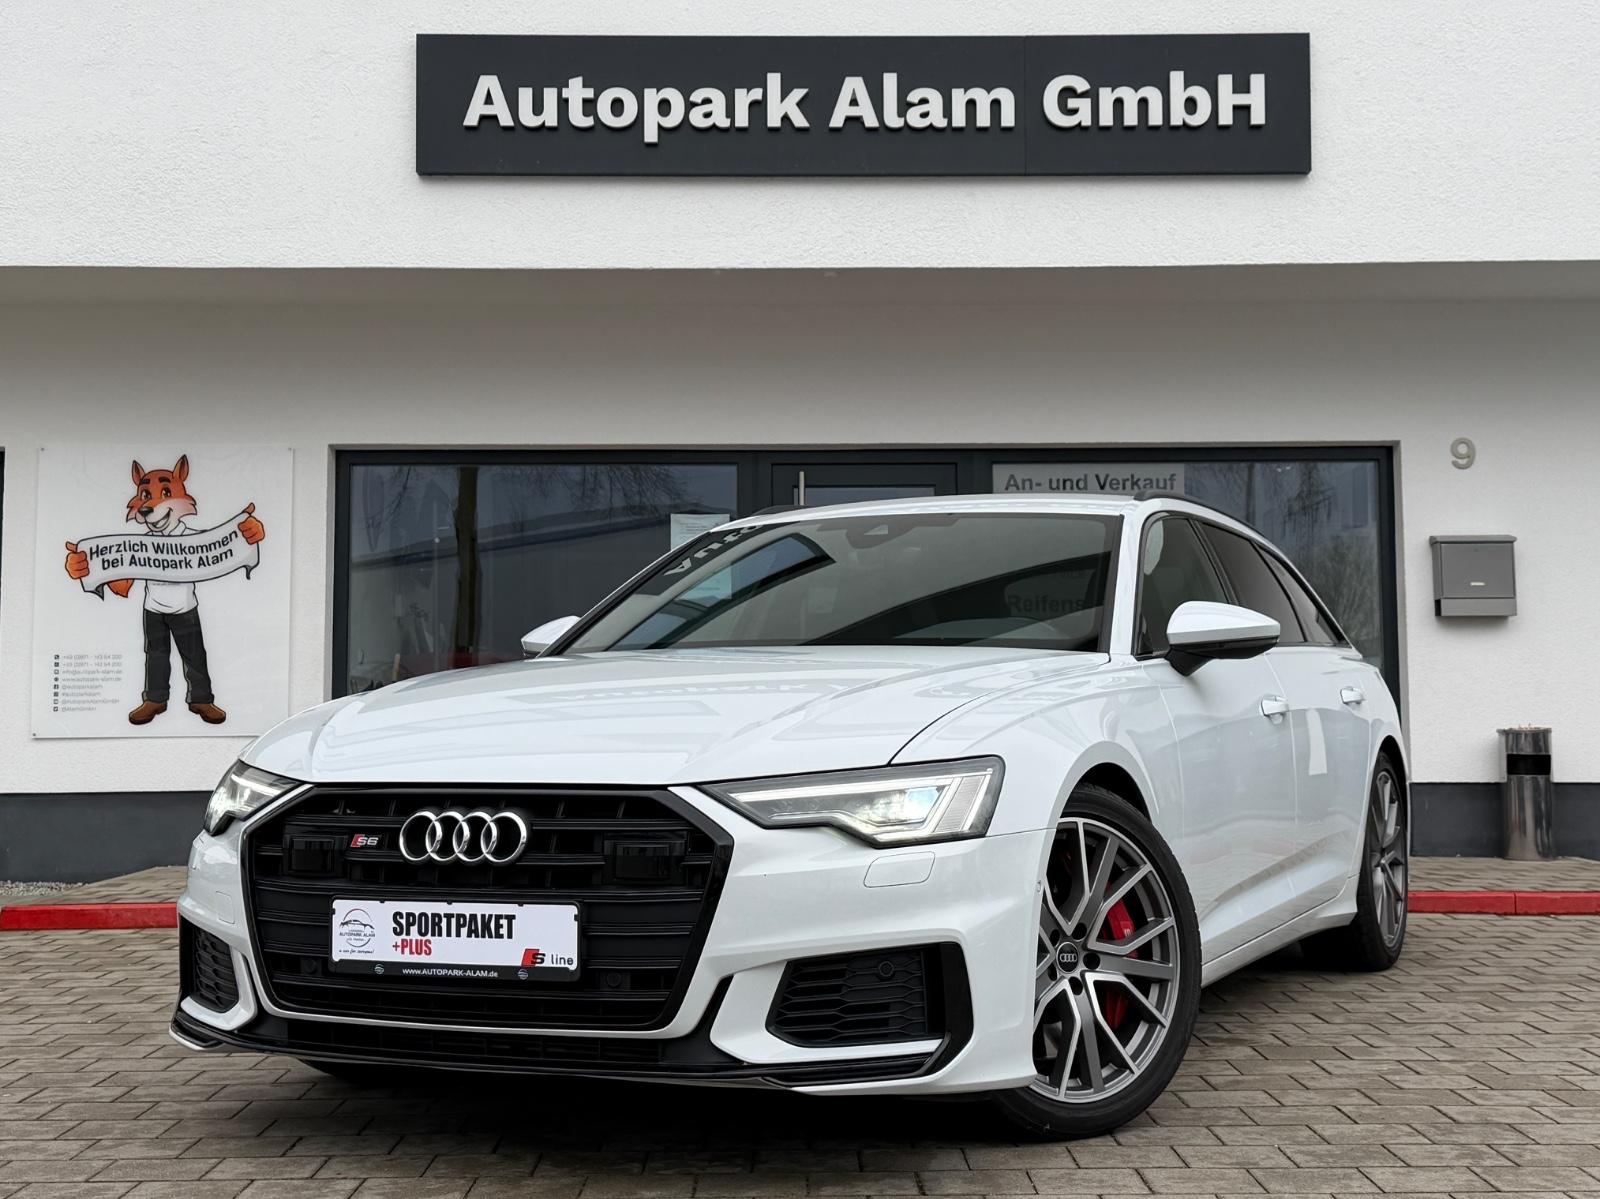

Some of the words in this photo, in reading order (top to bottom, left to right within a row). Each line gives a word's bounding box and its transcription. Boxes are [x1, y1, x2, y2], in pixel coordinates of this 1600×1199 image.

[462, 72, 811, 145] Autopark
[828, 72, 1017, 131] Alam
[1042, 71, 1268, 130] GmbH
[1450, 437, 1476, 470] 9
[1004, 474, 1042, 491] An-
[1048, 474, 1088, 491] und
[1095, 473, 1177, 491] Verkauf
[89, 540, 148, 561] Herzlich
[151, 530, 239, 556] Willkommen
[101, 554, 124, 571] bei
[129, 554, 193, 571] Autopark
[197, 548, 234, 569] Alam
[355, 836, 379, 846] S6
[392, 911, 516, 939] SPORTPAKET
[392, 938, 433, 956] +PLUS
[551, 954, 574, 966] line
[402, 968, 499, 978] www.AUTOPARK-ALAM.de
